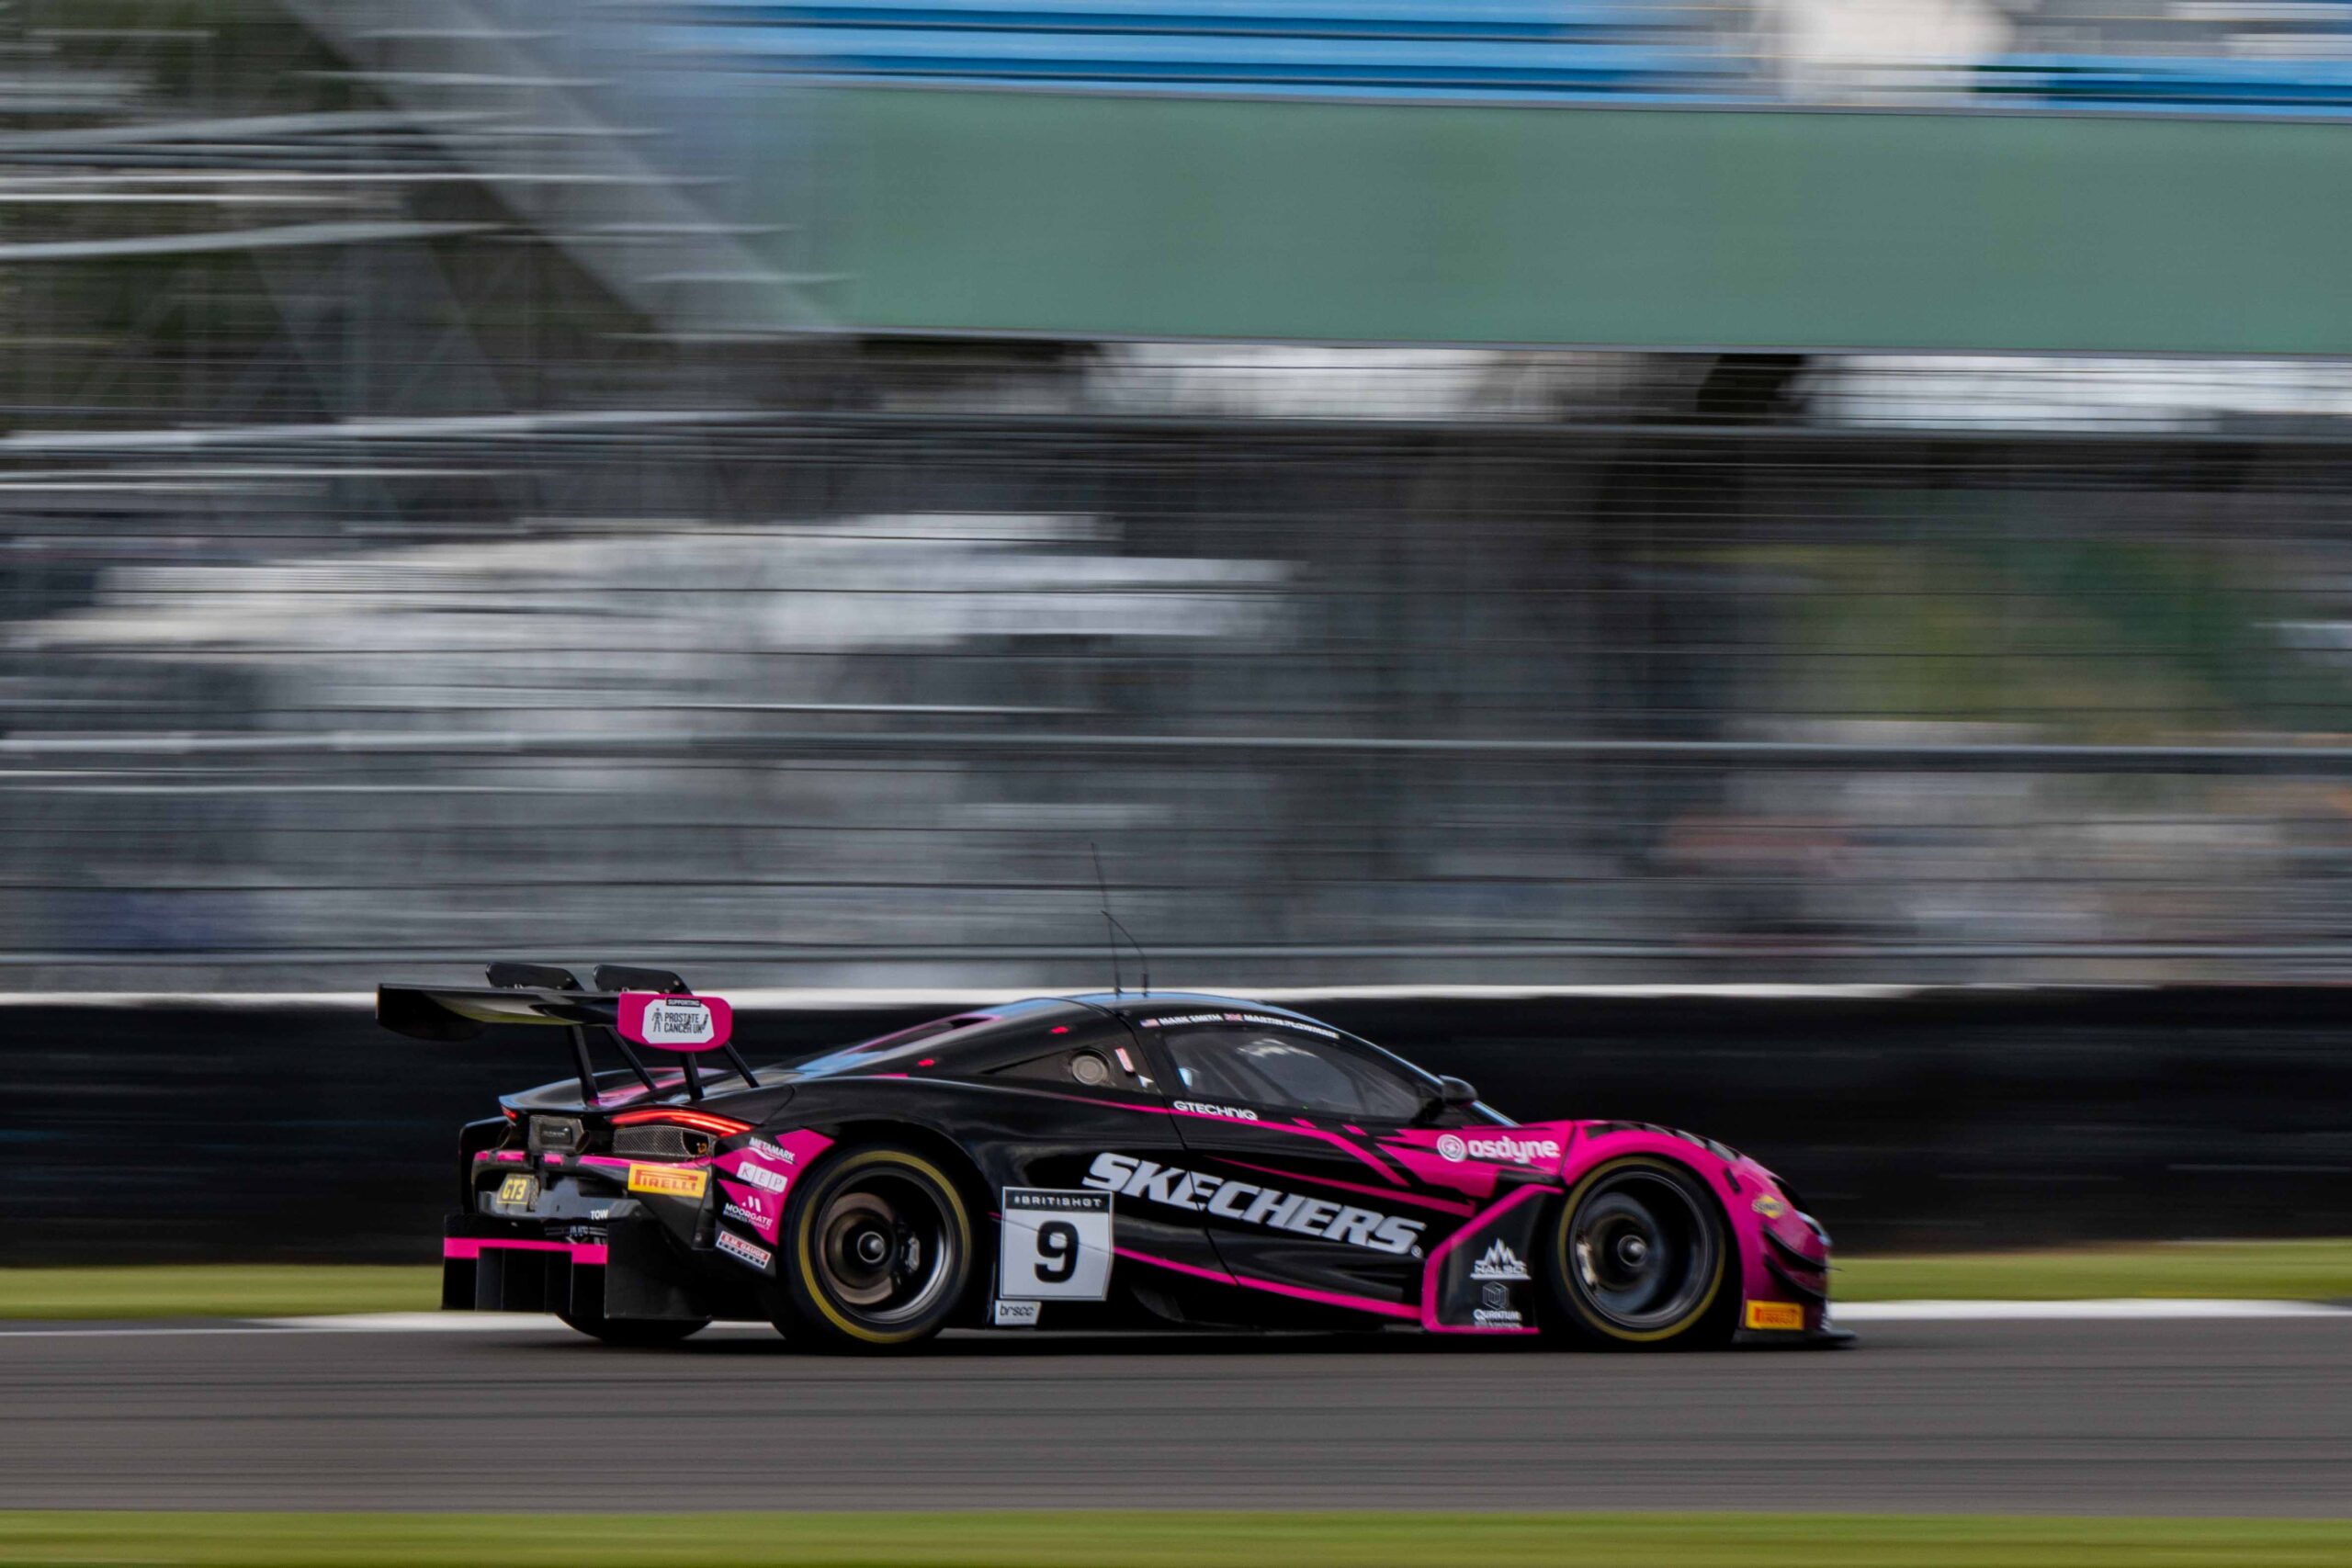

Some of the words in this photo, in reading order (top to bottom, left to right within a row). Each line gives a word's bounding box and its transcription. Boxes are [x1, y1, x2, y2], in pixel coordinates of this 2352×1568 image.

[663, 1022, 692, 1033] CANCER
[693, 1024, 703, 1034] UK
[664, 1012, 699, 1023] PROSTATE
[1158, 1017, 1191, 1026] MARK
[1189, 1014, 1222, 1023] SMITH
[1243, 1014, 1285, 1026] MARTIN
[748, 1137, 796, 1161] METAMARK
[1467, 1135, 1561, 1164] osdyne
[502, 1179, 526, 1201] GT3
[635, 1168, 698, 1191] PIRELLI
[724, 1202, 774, 1226] MOORGATE
[1082, 1152, 1427, 1255] SKECHERS
[590, 1209, 609, 1221] TOW
[1034, 1220, 1080, 1283] 9
[1000, 1303, 1035, 1316] brscc
